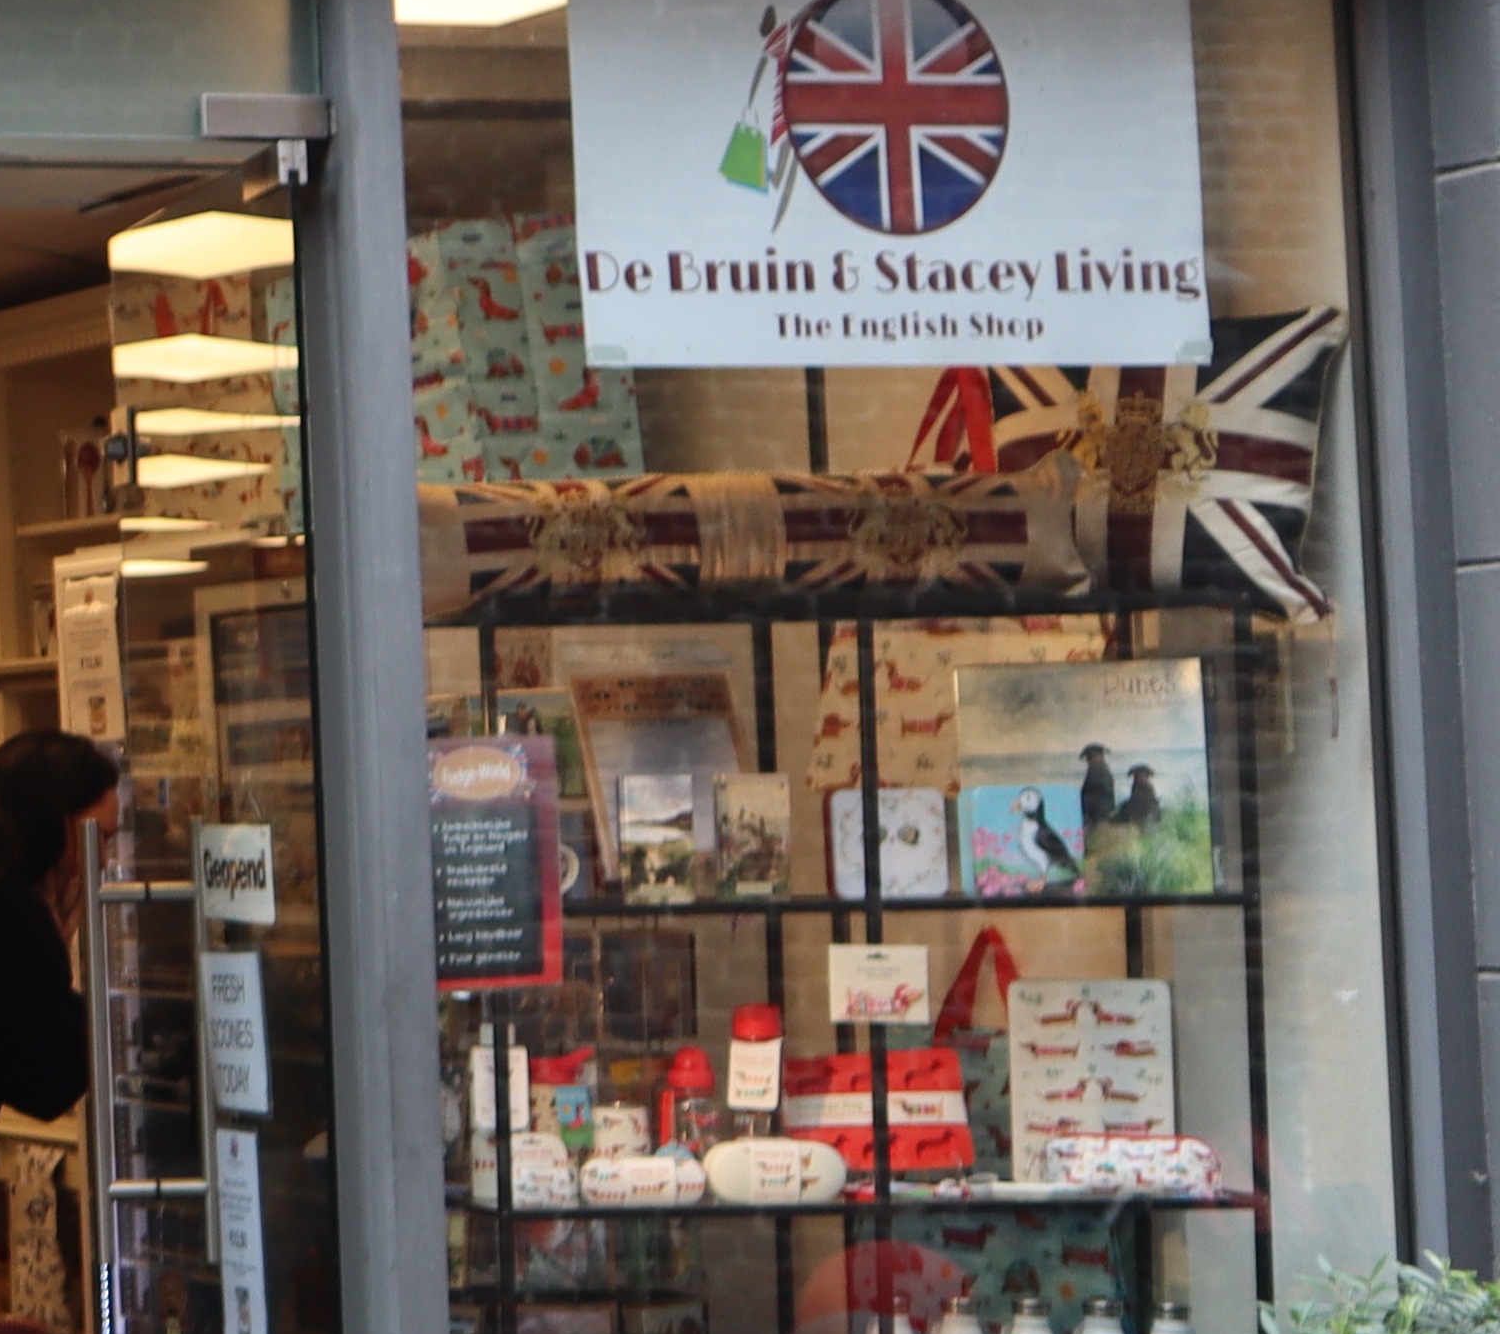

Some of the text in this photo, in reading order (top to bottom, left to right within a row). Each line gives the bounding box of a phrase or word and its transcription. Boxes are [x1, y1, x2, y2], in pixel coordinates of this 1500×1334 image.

[584, 247, 1202, 301] De Bruin & Stacey Living
[775, 312, 1045, 341] The English Shop
[203, 849, 267, 900] Geopend
[212, 974, 245, 1003] FRESH
[217, 1063, 250, 1093] TODAY
